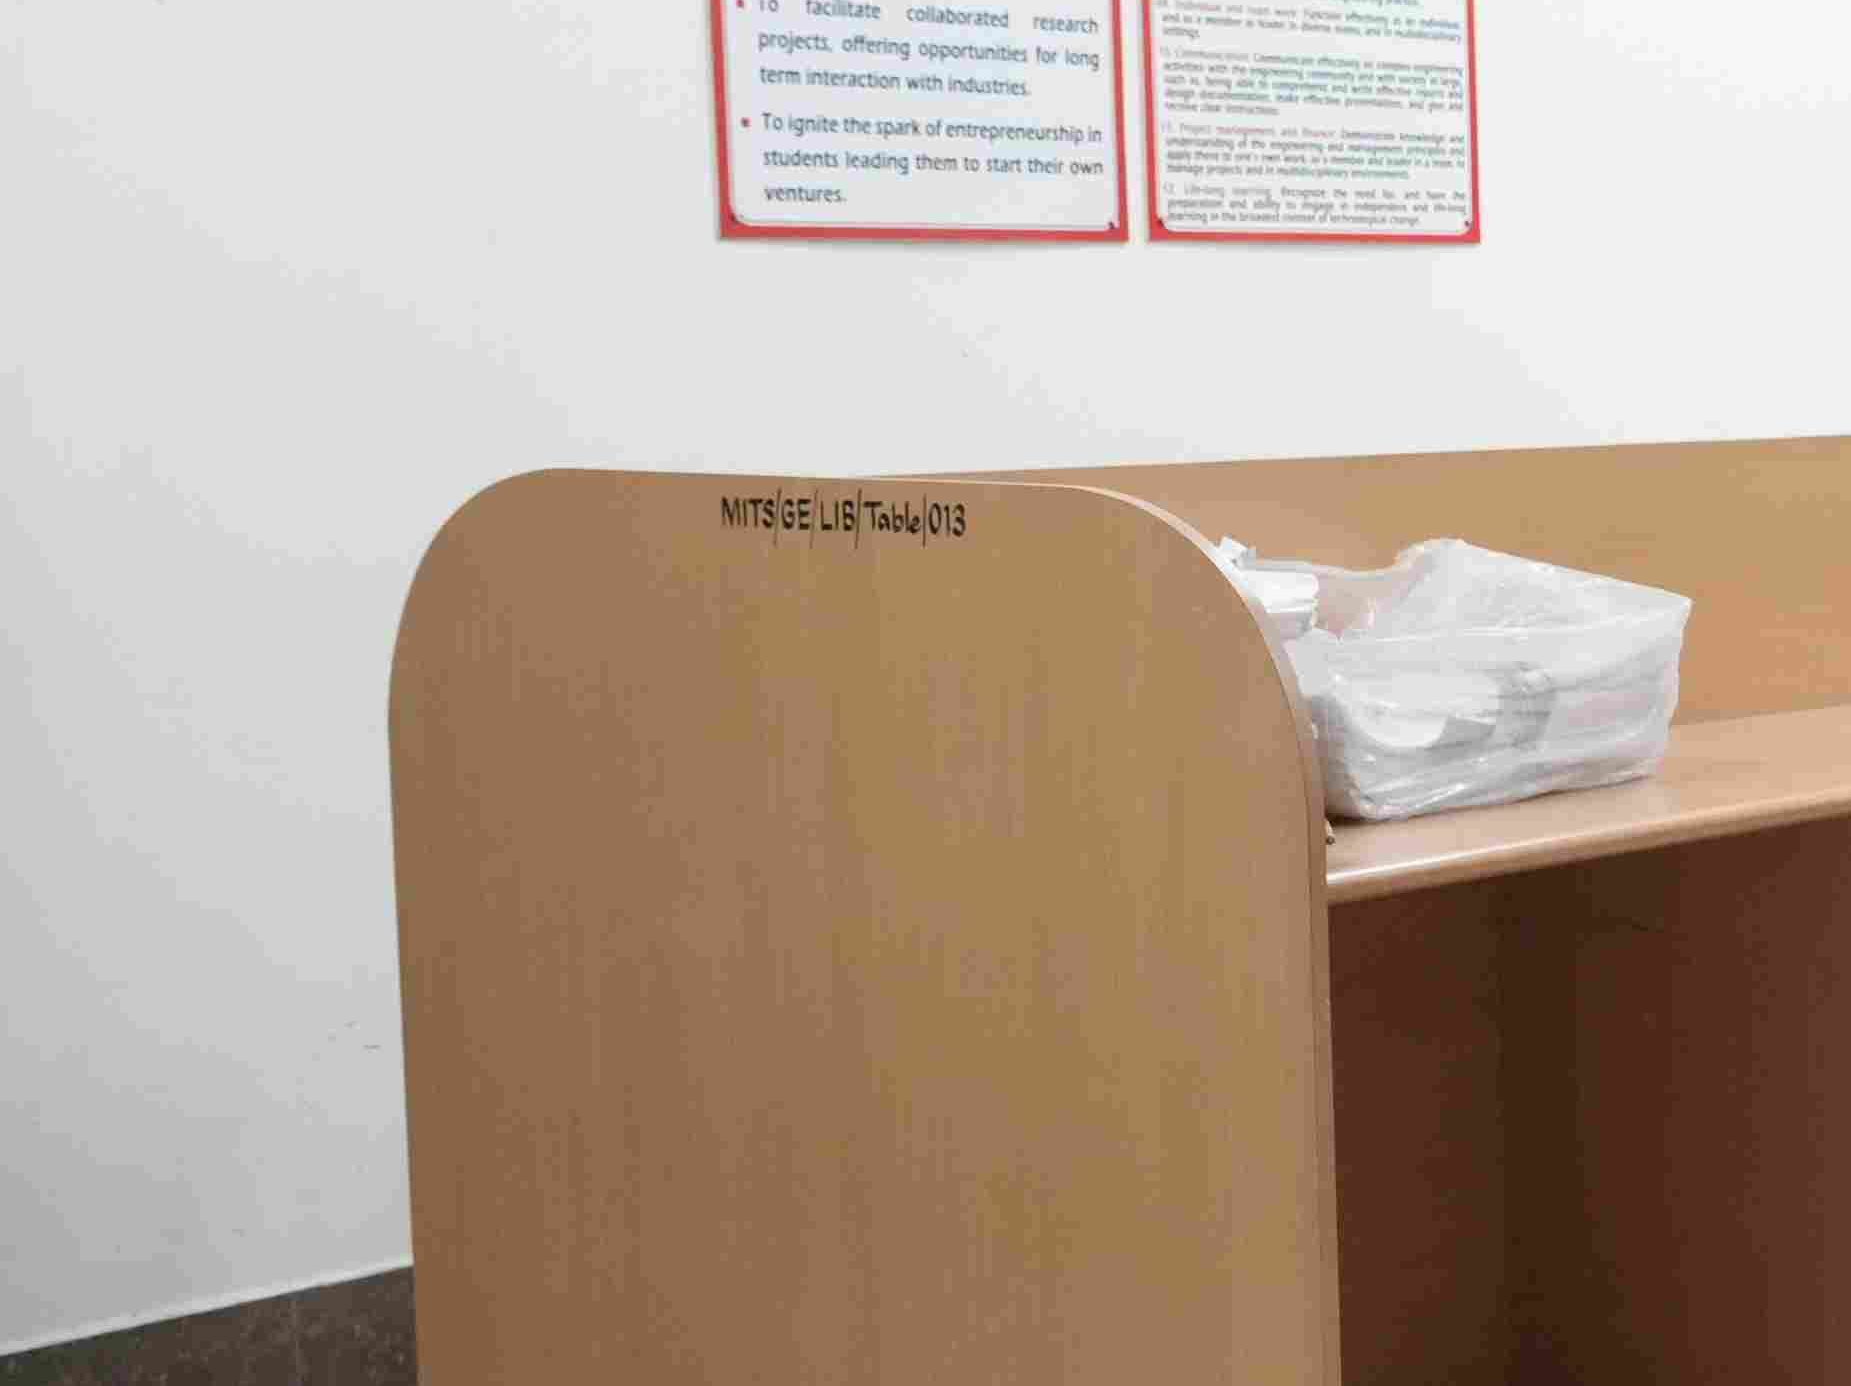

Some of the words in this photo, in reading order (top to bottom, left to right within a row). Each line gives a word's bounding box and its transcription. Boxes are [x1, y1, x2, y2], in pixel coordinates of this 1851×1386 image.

[905, 5, 1008, 27] collaborated
[1032, 16, 1099, 33] research
[841, 34, 911, 60] offering
[917, 42, 1028, 62] opportunities
[1035, 45, 1058, 63] for
[1064, 48, 1100, 70] long
[759, 66, 800, 84] term
[805, 69, 900, 89] interaction
[905, 74, 943, 91] with
[761, 111, 783, 131] To
[787, 115, 839, 137] ignite
[842, 117, 872, 134] the
[874, 119, 922, 140] spark
[924, 118, 942, 137] of
[944, 124, 1084, 145] entrepreneurship
[1087, 125, 1102, 142] in
[762, 149, 839, 167] students
[844, 151, 909, 174] leading
[913, 153, 958, 170] them
[961, 156, 980, 172] to
[985, 157, 1021, 172] start
[1026, 157, 1064, 173] their
[1069, 158, 1104, 175] own
